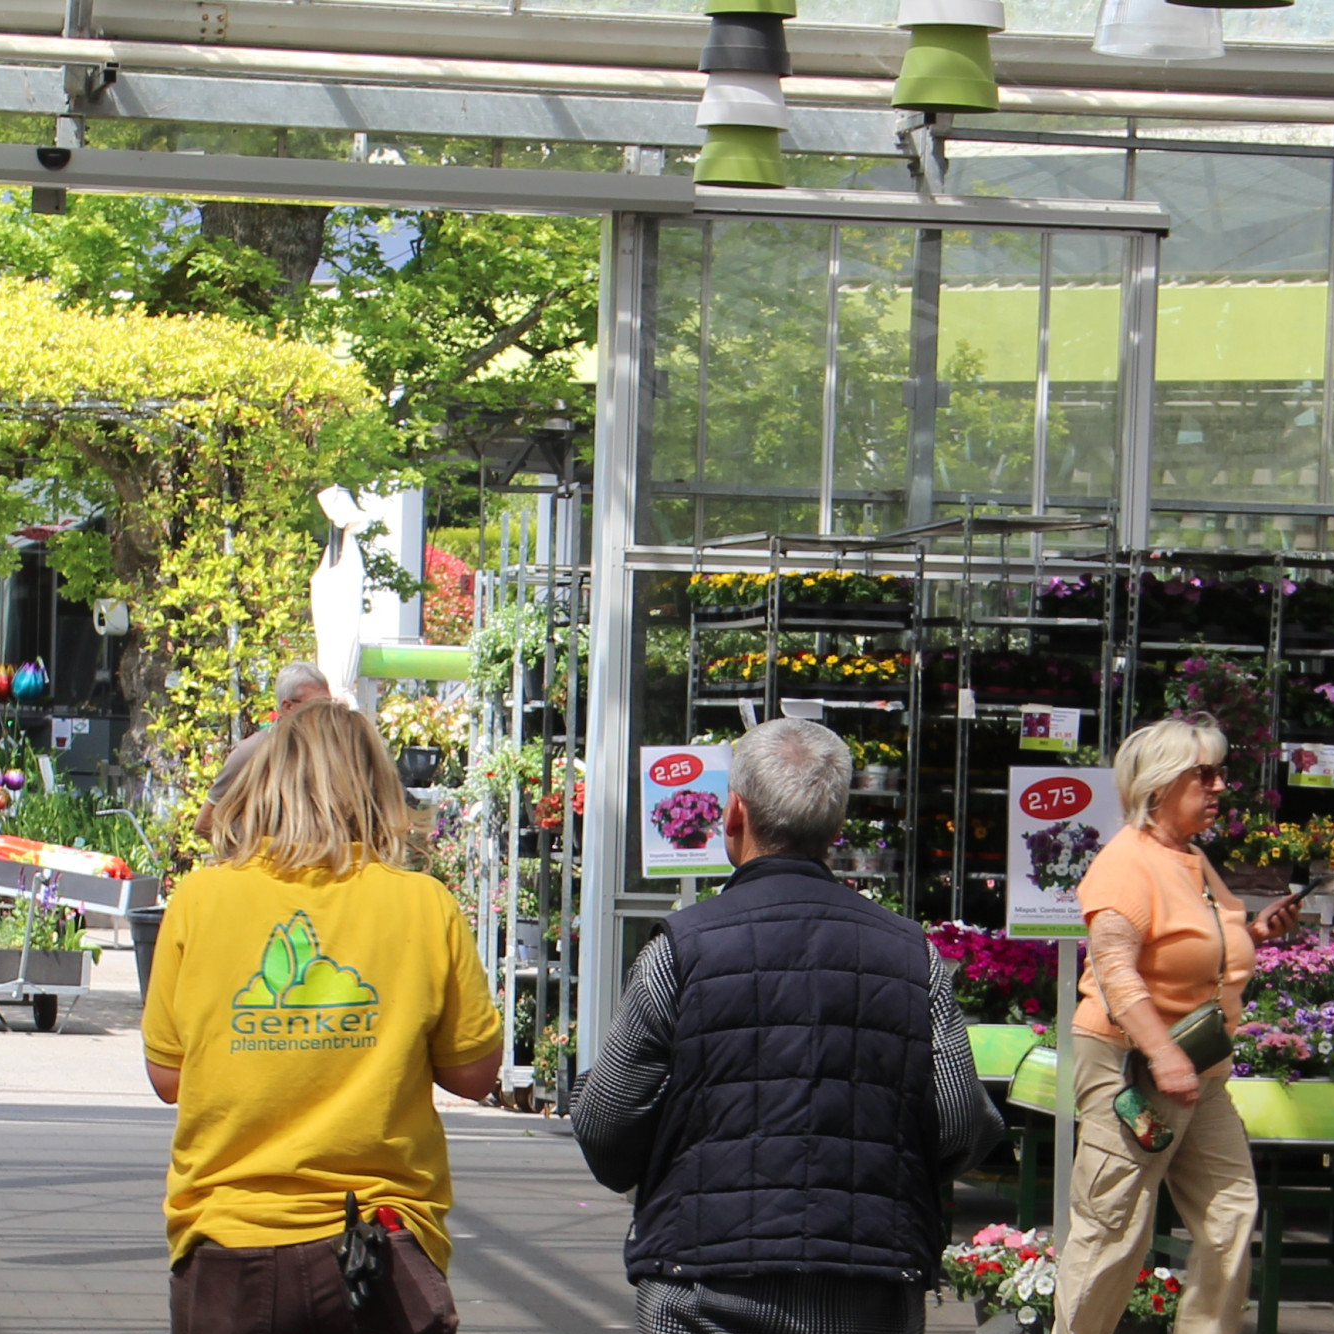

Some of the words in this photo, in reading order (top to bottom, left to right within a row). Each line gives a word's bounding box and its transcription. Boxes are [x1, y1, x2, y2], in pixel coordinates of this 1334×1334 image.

[654, 761, 692, 781] 2,25
[1027, 786, 1076, 811] 2,75
[231, 1011, 379, 1034] Genker
[230, 1036, 377, 1054] plantencentrum
